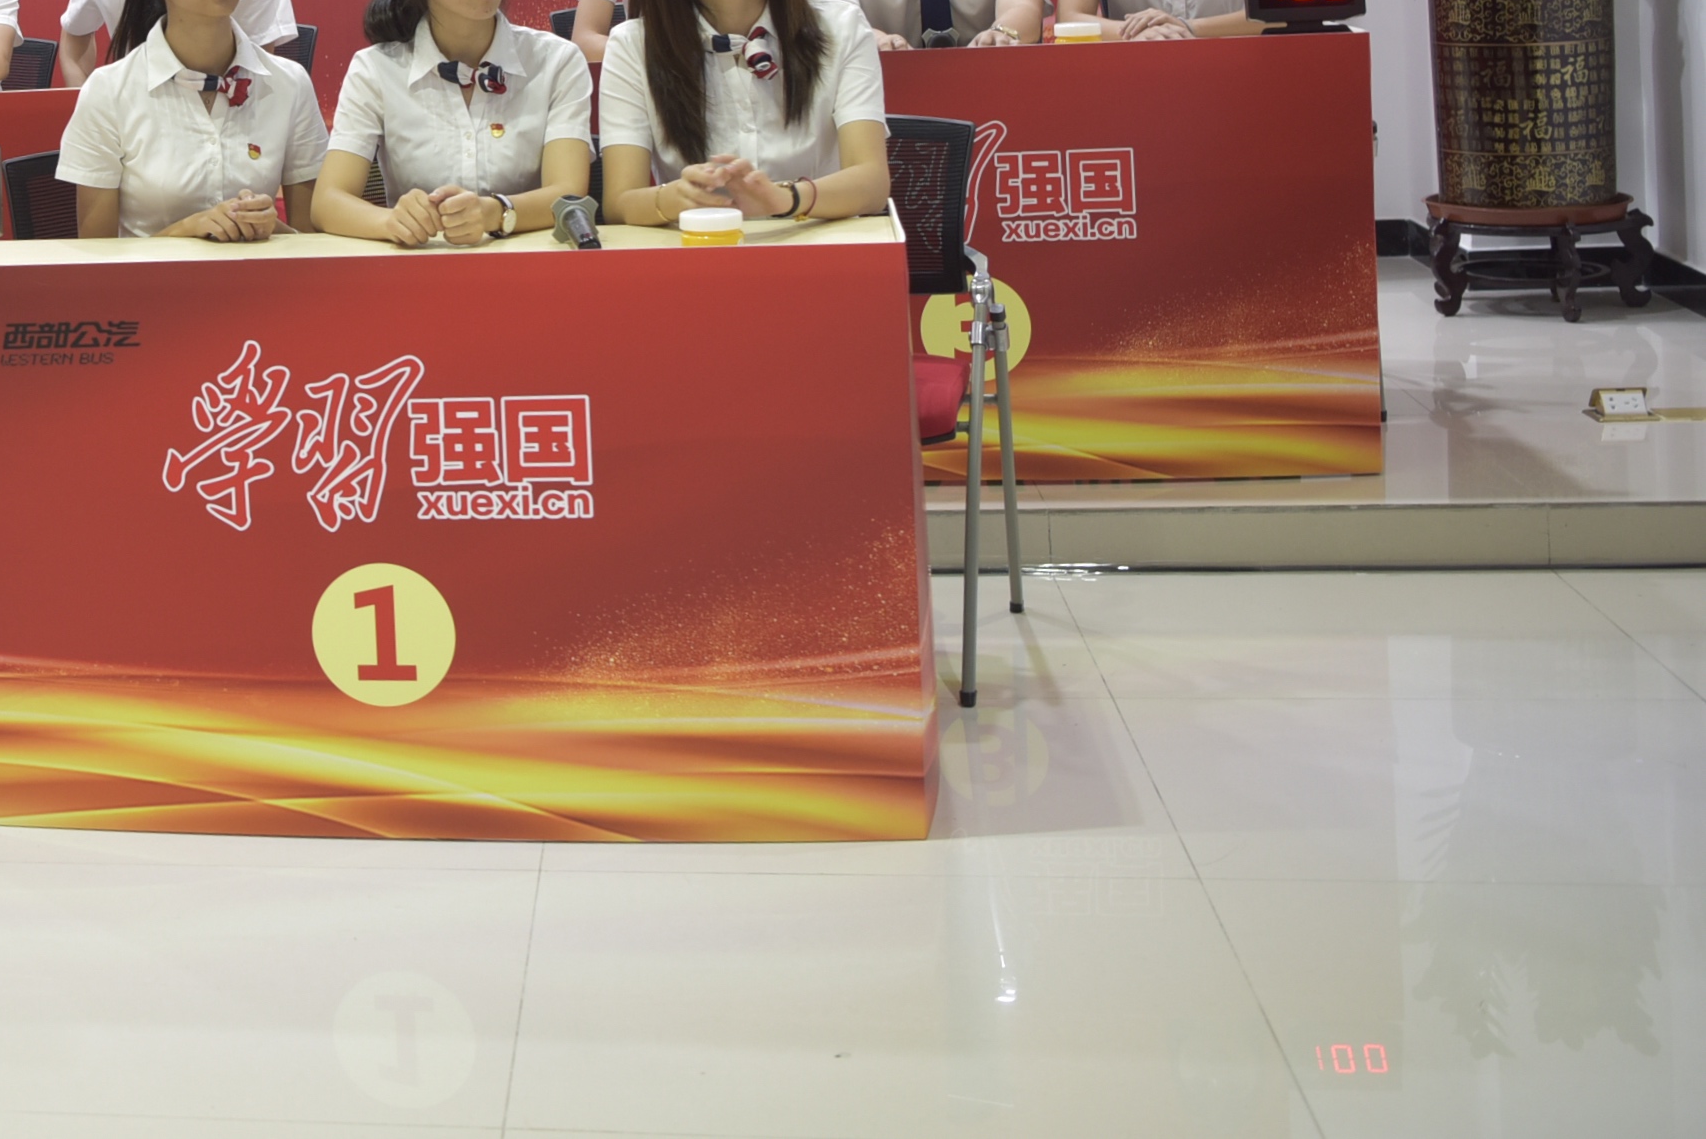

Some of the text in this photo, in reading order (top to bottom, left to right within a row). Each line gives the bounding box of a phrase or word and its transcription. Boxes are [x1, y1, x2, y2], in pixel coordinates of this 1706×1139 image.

[1561, 57, 1589, 85] 福
[1520, 112, 1553, 140] 福
[1002, 213, 1137, 242] xuexi.cn
[3, 321, 140, 350] 西部公汽
[79, 352, 114, 365] BUS
[417, 484, 594, 520] xuexi.cn
[353, 585, 418, 682] 1
